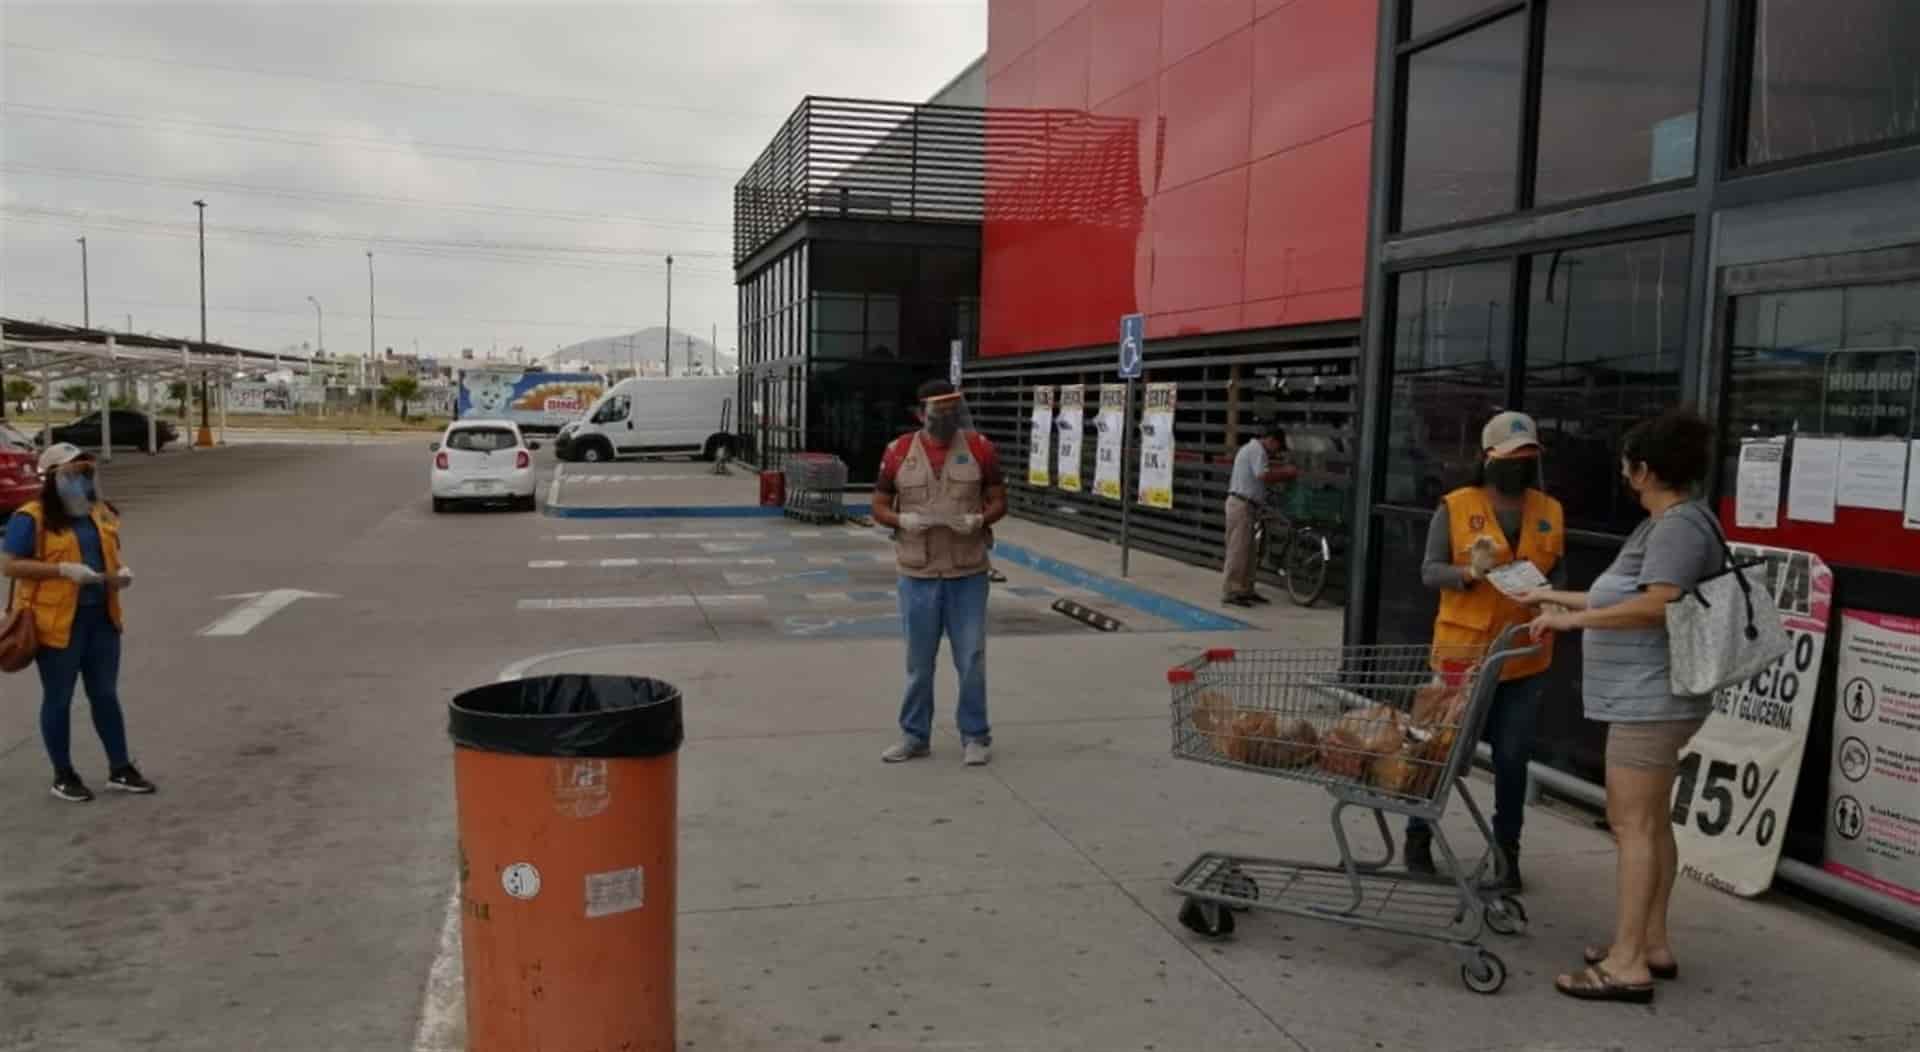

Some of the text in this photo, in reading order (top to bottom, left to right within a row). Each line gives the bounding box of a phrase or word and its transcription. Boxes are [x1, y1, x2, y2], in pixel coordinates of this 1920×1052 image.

[1829, 371, 1913, 391] HORARIO
[1739, 694, 1793, 732] GLUCERNA
[1671, 751, 1779, 847] 15%
